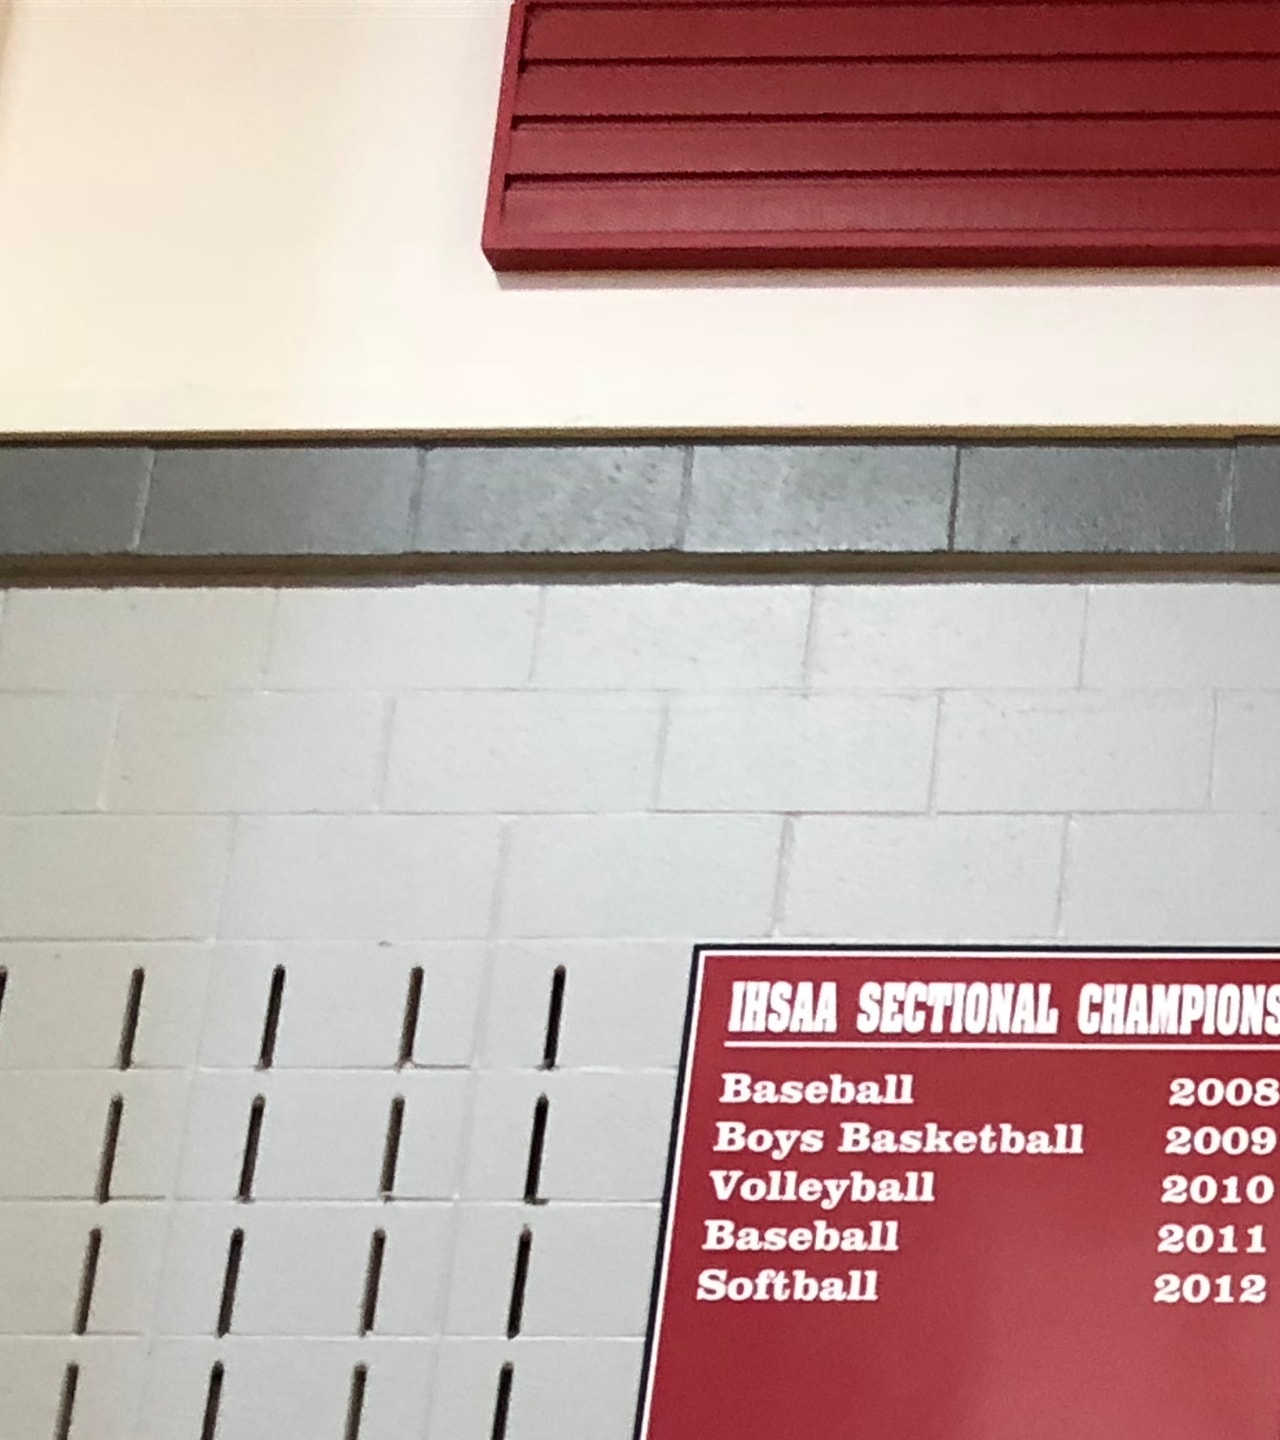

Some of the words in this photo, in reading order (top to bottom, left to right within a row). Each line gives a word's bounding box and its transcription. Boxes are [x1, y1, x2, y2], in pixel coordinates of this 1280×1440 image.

[728, 981, 839, 1033] IHSAA
[856, 982, 1058, 1035] SECTIONAL
[719, 1074, 913, 1105] Baseball
[1168, 1078, 1280, 1107] 2008
[714, 1122, 824, 1160] Boys
[838, 1123, 1084, 1154] Basketball
[1164, 1126, 1278, 1156] 2009
[709, 1170, 935, 1210] Volleyball
[1161, 1175, 1274, 1205] 2010
[702, 1221, 899, 1252] Baseball
[1156, 1224, 1266, 1254] 2011
[696, 1269, 878, 1302] Softball
[1153, 1273, 1267, 1304] 2012
